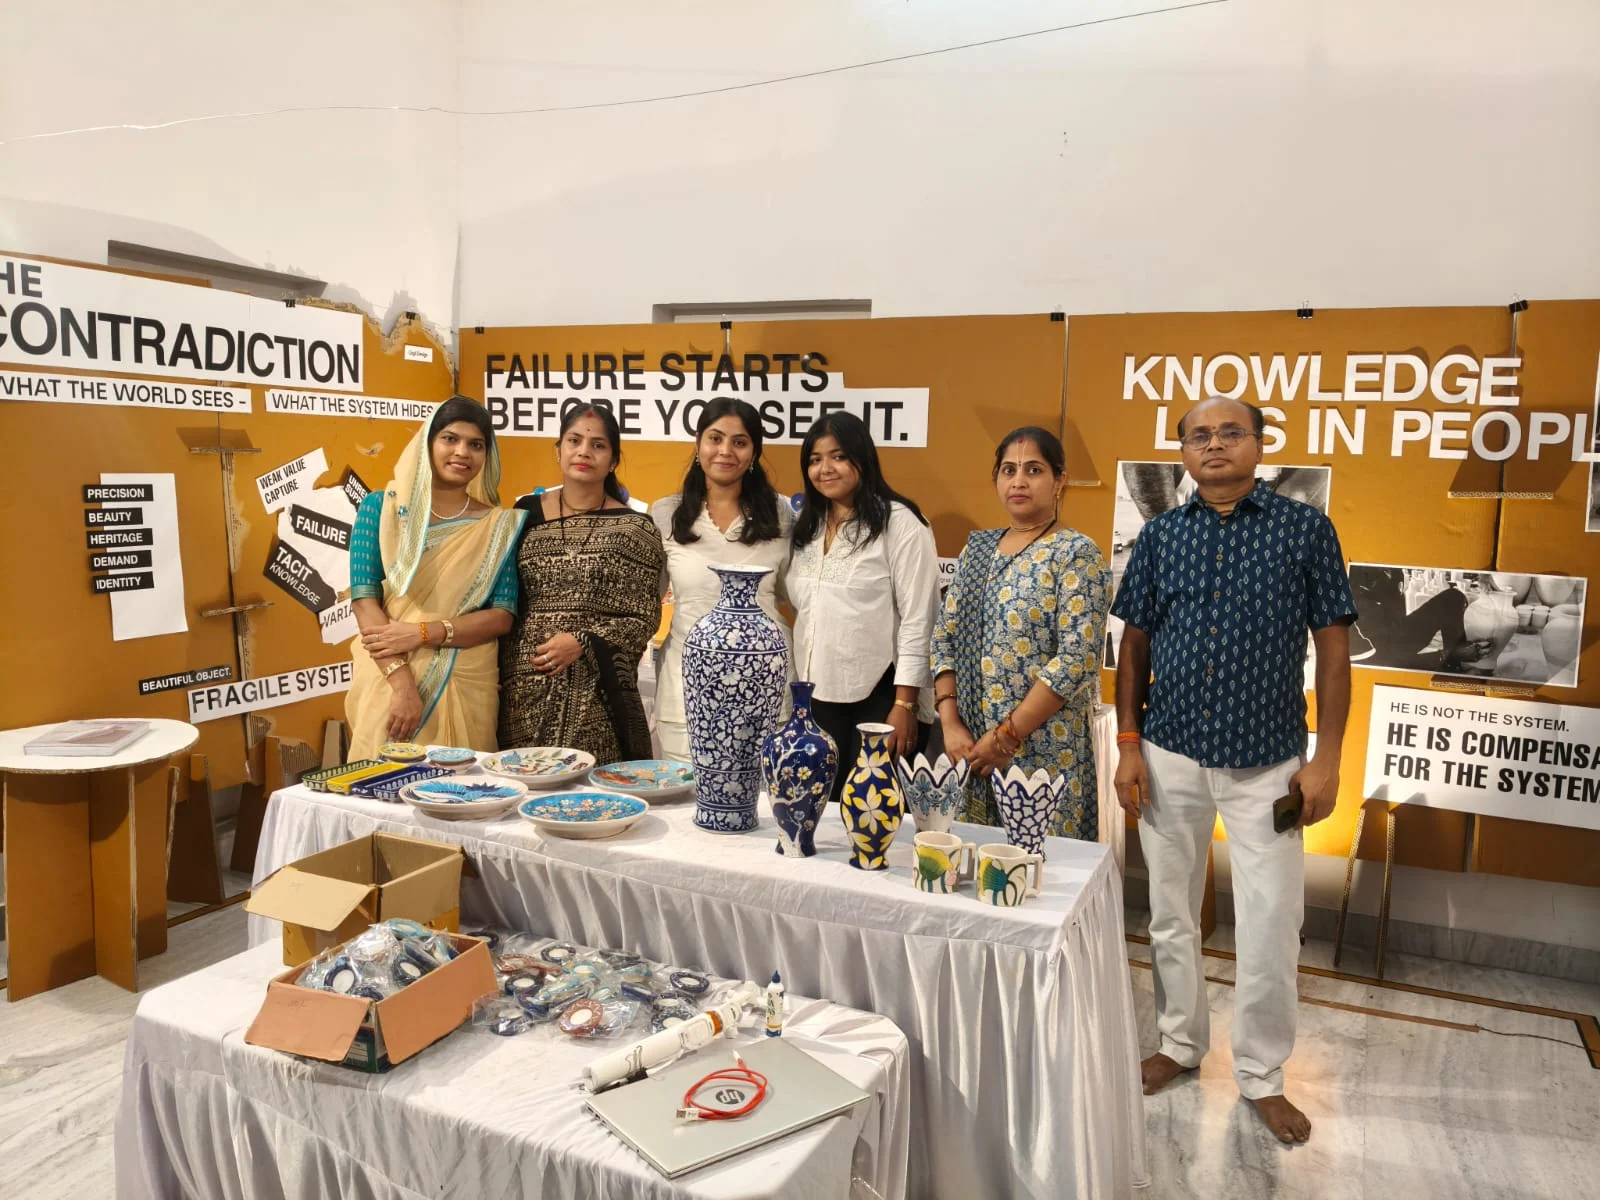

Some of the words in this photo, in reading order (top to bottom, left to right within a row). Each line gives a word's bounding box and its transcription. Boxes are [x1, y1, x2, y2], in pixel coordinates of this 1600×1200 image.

[486, 354, 646, 390] FAILURE
[660, 352, 829, 393] STARTS
[1122, 354, 1522, 406] KNOWLEDGE
[67, 380, 107, 400] THE
[113, 382, 187, 406] WORLD
[192, 390, 234, 408] SEES
[272, 393, 317, 411] WHAT
[320, 397, 345, 413] THE
[349, 399, 398, 417] SYSTEM
[402, 404, 433, 418] HIDES
[654, 399, 708, 437] YO
[863, 402, 908, 441] IT.
[1154, 406, 1287, 454] LS
[1307, 408, 1366, 455] IN
[259, 470, 283, 490] WEAK
[282, 458, 307, 477] VALUE
[349, 474, 368, 498] UNRE
[87, 488, 145, 500] PRECISION
[264, 478, 299, 505] CAPTURE
[89, 512, 132, 523] BEAUTY
[296, 515, 347, 545] FAILURE
[90, 533, 143, 545] HERITAGE
[93, 554, 138, 567] DEMAND
[277, 547, 312, 582] TACIT
[96, 576, 141, 590] IDENTITY
[269, 562, 320, 606] KNOWLEDGE
[142, 674, 194, 692] BEAUTIFUL
[196, 667, 232, 682] OBJECT.
[192, 675, 291, 714] FRAGILE
[296, 662, 354, 692] SYSTE
[1390, 701, 1410, 714] HE
[1414, 704, 1428, 716] IS
[1432, 706, 1464, 720] NOT
[1469, 710, 1498, 724] THE
[1503, 714, 1570, 732] SYSTEM.
[1387, 722, 1418, 748] HE
[1426, 726, 1452, 752] IS
[1384, 753, 1431, 781] FOR
[1442, 760, 1488, 789] THE
